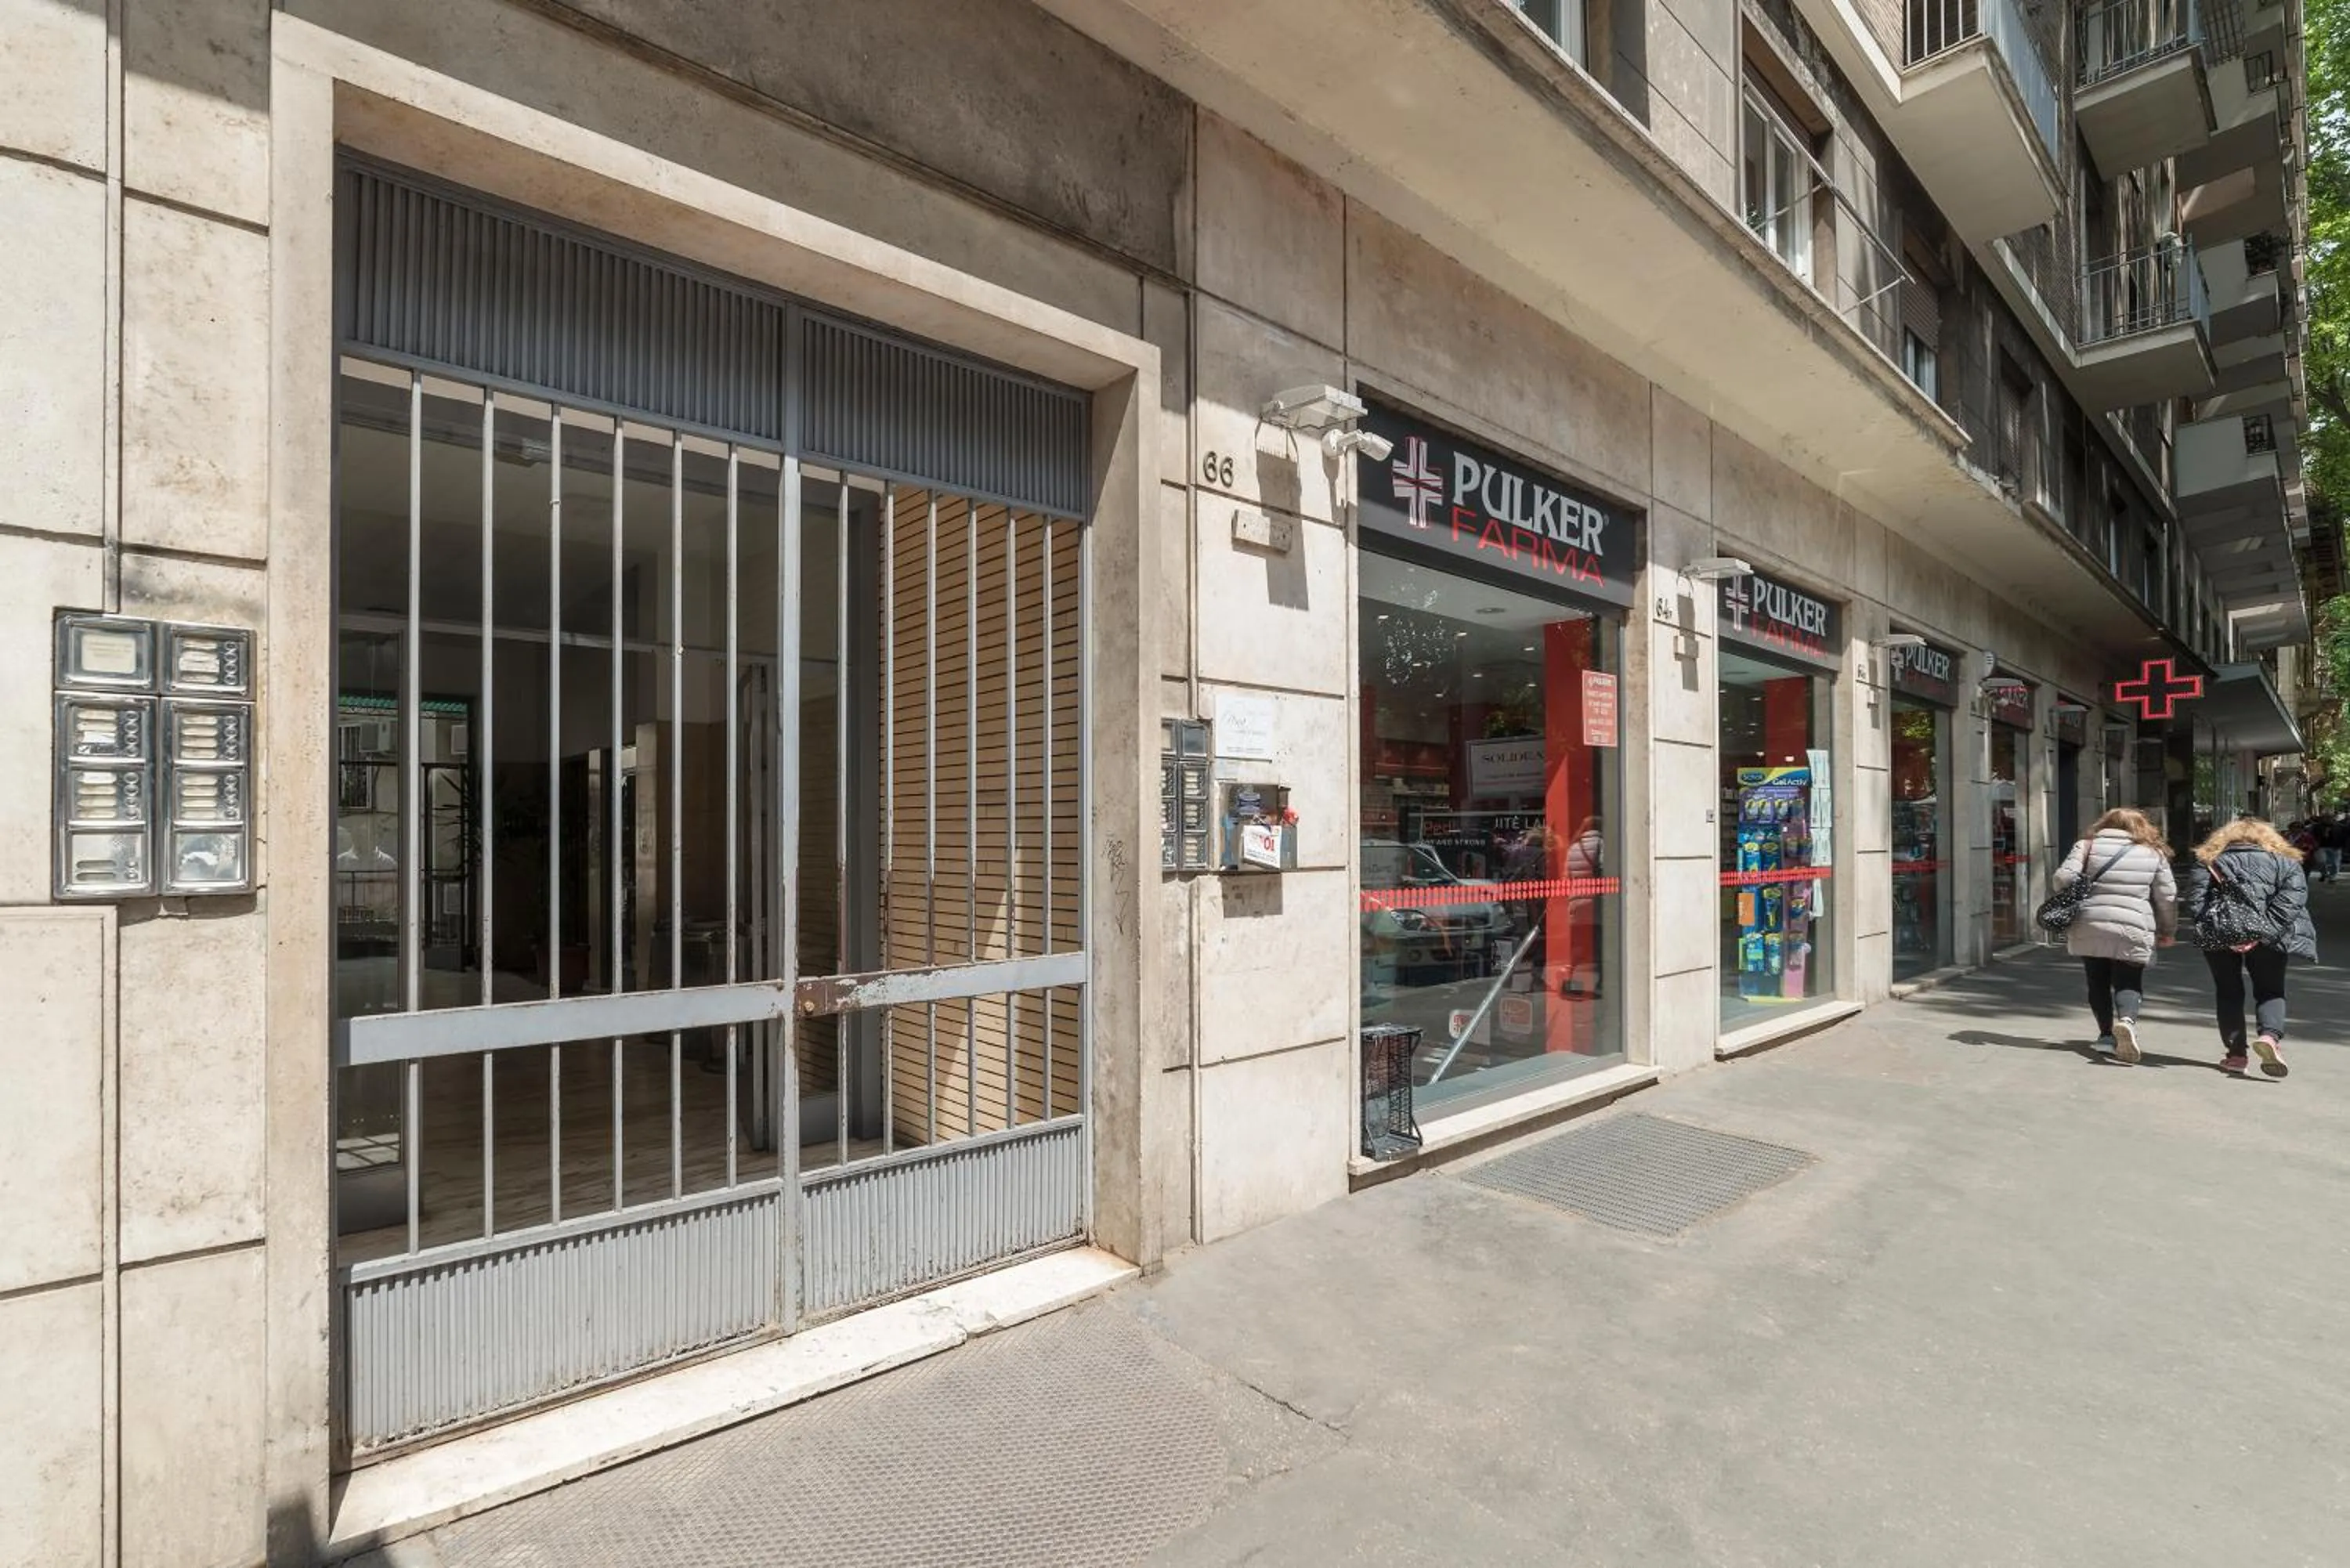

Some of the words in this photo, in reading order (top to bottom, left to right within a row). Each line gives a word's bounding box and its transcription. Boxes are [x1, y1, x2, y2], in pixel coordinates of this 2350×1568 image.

[1203, 451, 1234, 488] 66
[1452, 451, 1604, 556] PULKER
[1452, 506, 1605, 587] FARMA
[1752, 576, 1827, 637] PULKER
[1905, 644, 1950, 681] PULKER
